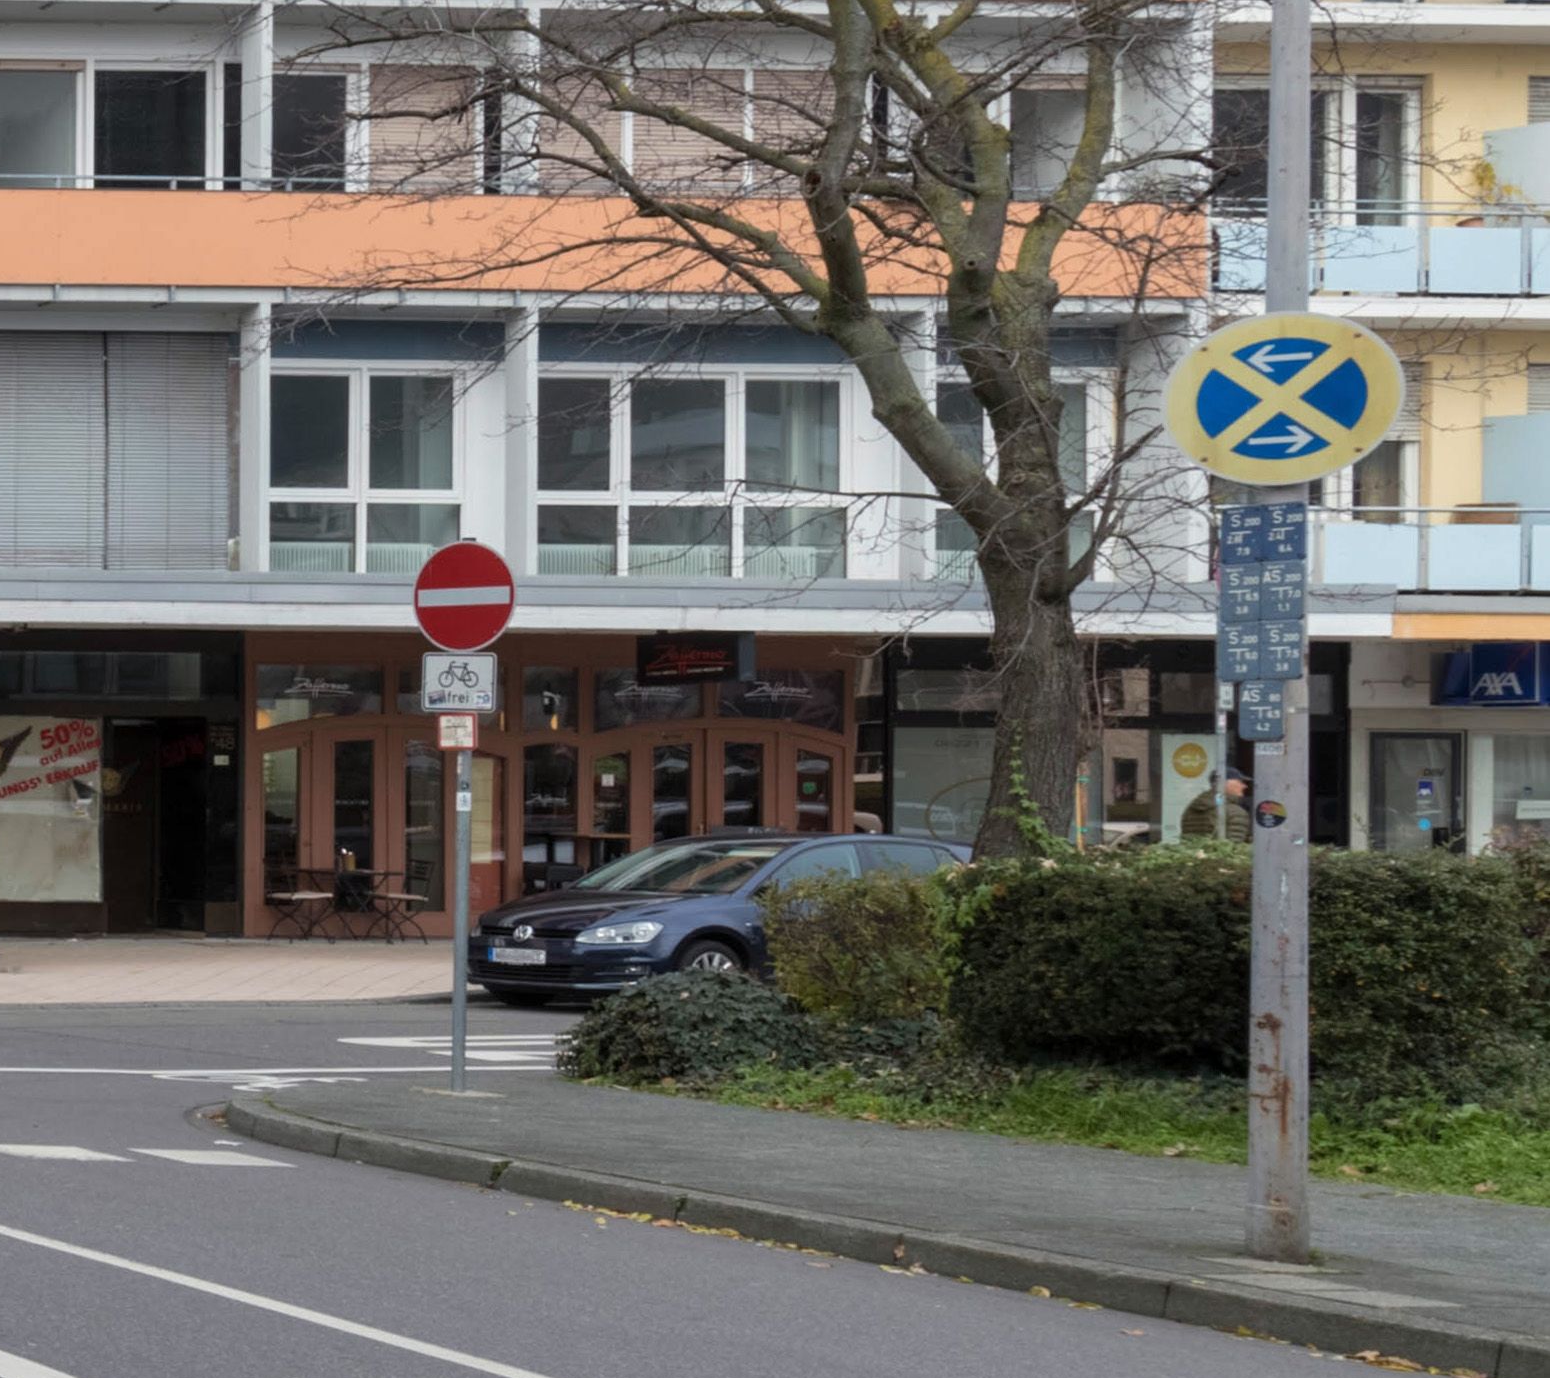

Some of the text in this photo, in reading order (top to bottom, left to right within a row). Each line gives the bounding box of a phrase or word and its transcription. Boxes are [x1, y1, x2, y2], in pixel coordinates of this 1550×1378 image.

[1231, 514, 1241, 527] S
[1273, 511, 1283, 524] S
[1229, 573, 1240, 586] S
[1262, 569, 1282, 583] AS
[1228, 631, 1258, 645] S 200
[1270, 629, 1300, 643] S 200
[1470, 673, 1524, 696] AXA
[447, 690, 469, 703] frei
[1241, 689, 1260, 703] AS
[40, 718, 95, 750] 50%
[40, 749, 64, 767] auf
